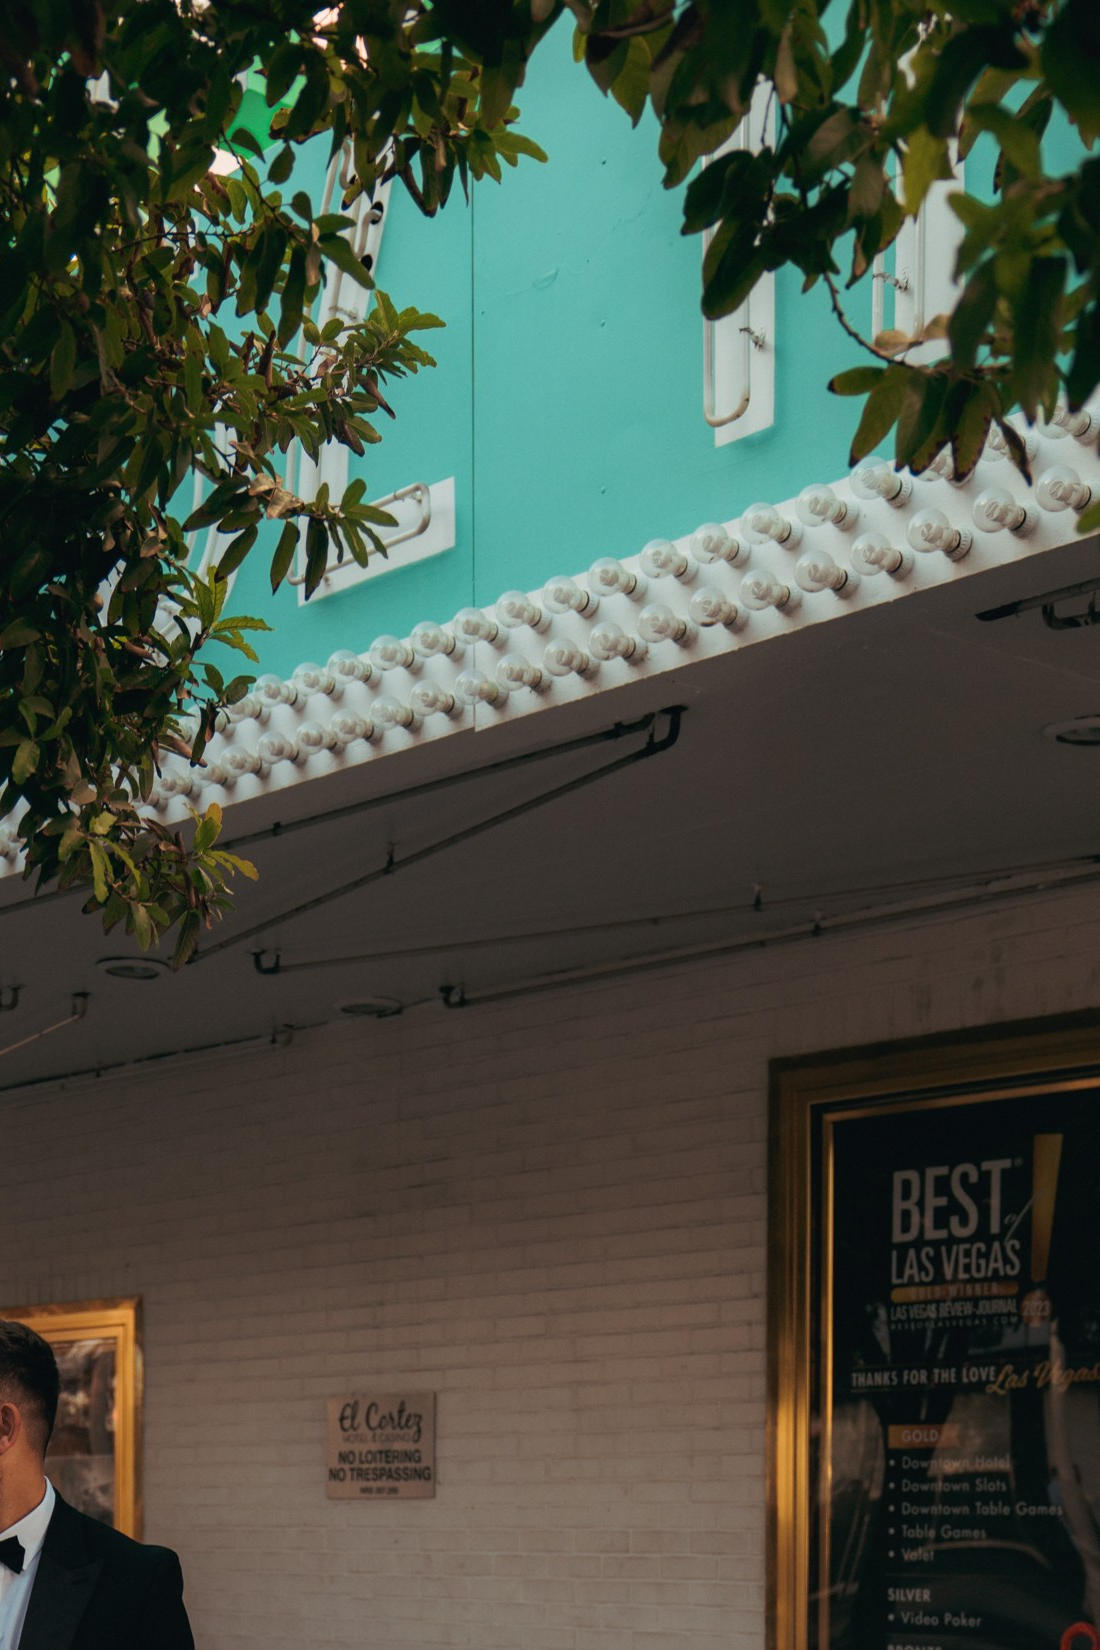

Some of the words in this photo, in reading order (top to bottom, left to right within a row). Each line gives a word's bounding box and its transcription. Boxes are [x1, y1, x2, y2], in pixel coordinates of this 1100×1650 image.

[891, 1158, 1013, 1244] BEST
[890, 1246, 935, 1285] LAS
[940, 1239, 1021, 1281] VEGAS
[890, 1305, 908, 1321] LAS
[909, 1302, 938, 1319] VEGAS
[1022, 1300, 1050, 1317] 2023
[851, 1370, 898, 1387] THANKS
[903, 1368, 928, 1385] FOR
[932, 1366, 957, 1384] THE
[961, 1365, 996, 1382] LOVE
[985, 1364, 1029, 1396] Las
[338, 1400, 360, 1432] El
[365, 1400, 422, 1443] Cortez
[901, 1429, 939, 1443] GOLD
[338, 1450, 356, 1465] NO
[358, 1449, 421, 1464] LOITERING
[901, 1455, 970, 1470] Downtown
[975, 1454, 1011, 1469] Hotel
[329, 1468, 346, 1482] NO
[349, 1466, 432, 1482] TRESPASSING
[901, 1478, 970, 1493] Downtown
[975, 1477, 1007, 1493] Slots
[901, 1502, 970, 1516] Downtown
[975, 1501, 1011, 1516] Table
[1015, 1501, 1064, 1517] Games
[901, 1524, 936, 1539] Table
[940, 1524, 987, 1539] Games
[901, 1547, 935, 1562] Valet
[887, 1587, 931, 1602] SILVER
[901, 1610, 939, 1627] Video
[943, 1611, 982, 1628] Poker
